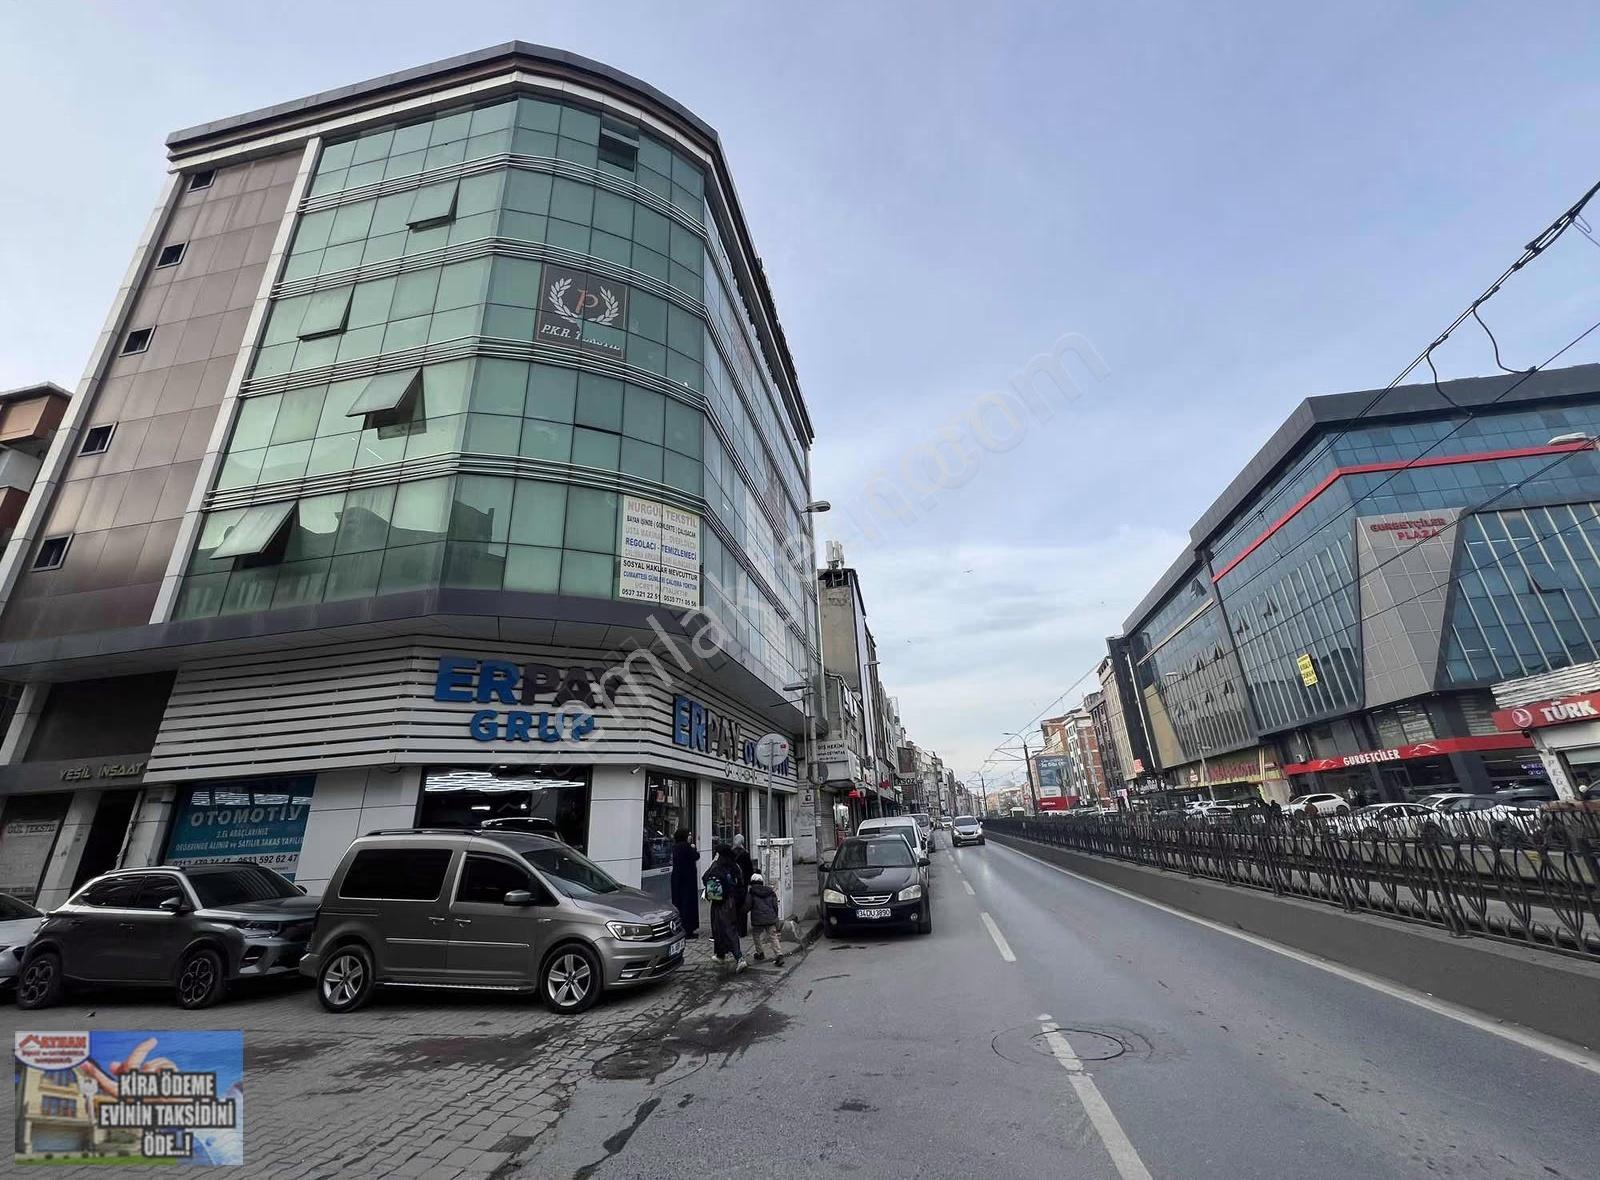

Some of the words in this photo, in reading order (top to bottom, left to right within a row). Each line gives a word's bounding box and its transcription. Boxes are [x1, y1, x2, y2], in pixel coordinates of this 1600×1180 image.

[623, 558, 644, 570] SOSYAL
[646, 591, 653, 599] 22
[433, 655, 622, 709] ERPAY
[1539, 700, 1599, 722] TÜRK
[470, 709, 595, 743] GRUP
[672, 693, 741, 762] ERPAY
[1343, 749, 1401, 766] GURBETÇİLER
[191, 804, 303, 827] OTOMOTİV
[259, 855, 274, 864] 592
[276, 855, 286, 863] 62
[288, 854, 299, 862] 47
